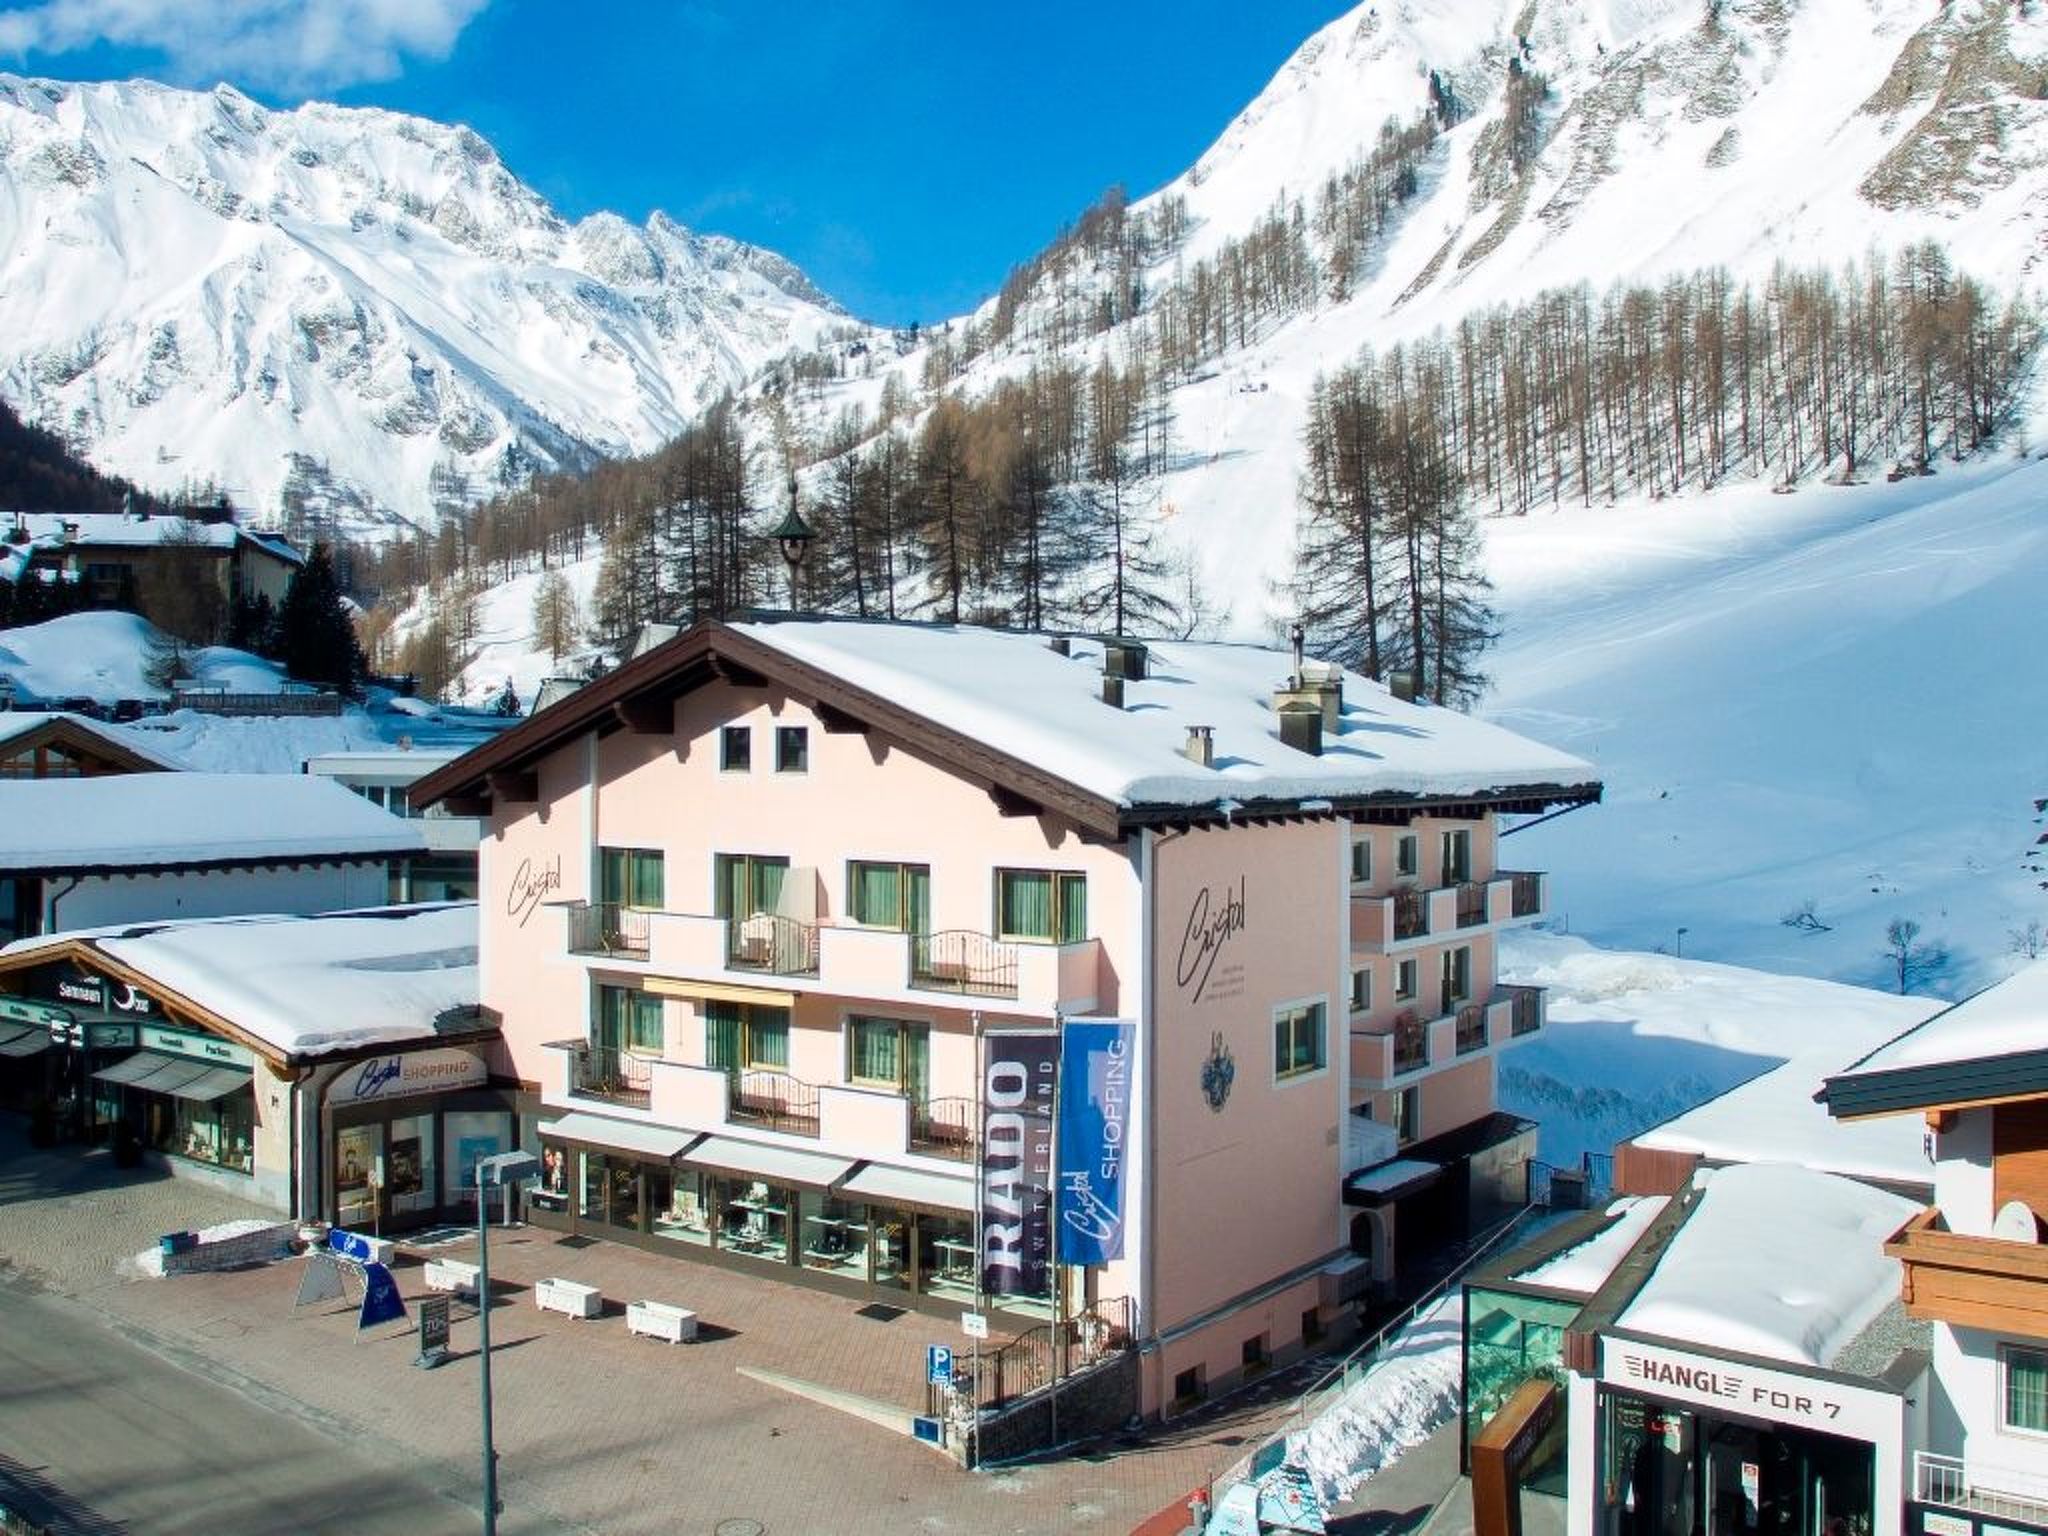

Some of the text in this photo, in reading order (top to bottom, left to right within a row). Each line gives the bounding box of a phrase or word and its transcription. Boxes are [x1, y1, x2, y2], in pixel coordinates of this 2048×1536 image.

[404, 1061, 471, 1081] SHOPPING
[1101, 1038, 1125, 1179] SHOPPING
[985, 1061, 1027, 1271] RADO
[1031, 1061, 1054, 1270] SWITZERLAND
[1752, 1386, 1811, 1415] FOR
[1823, 1402, 1842, 1419] 7
